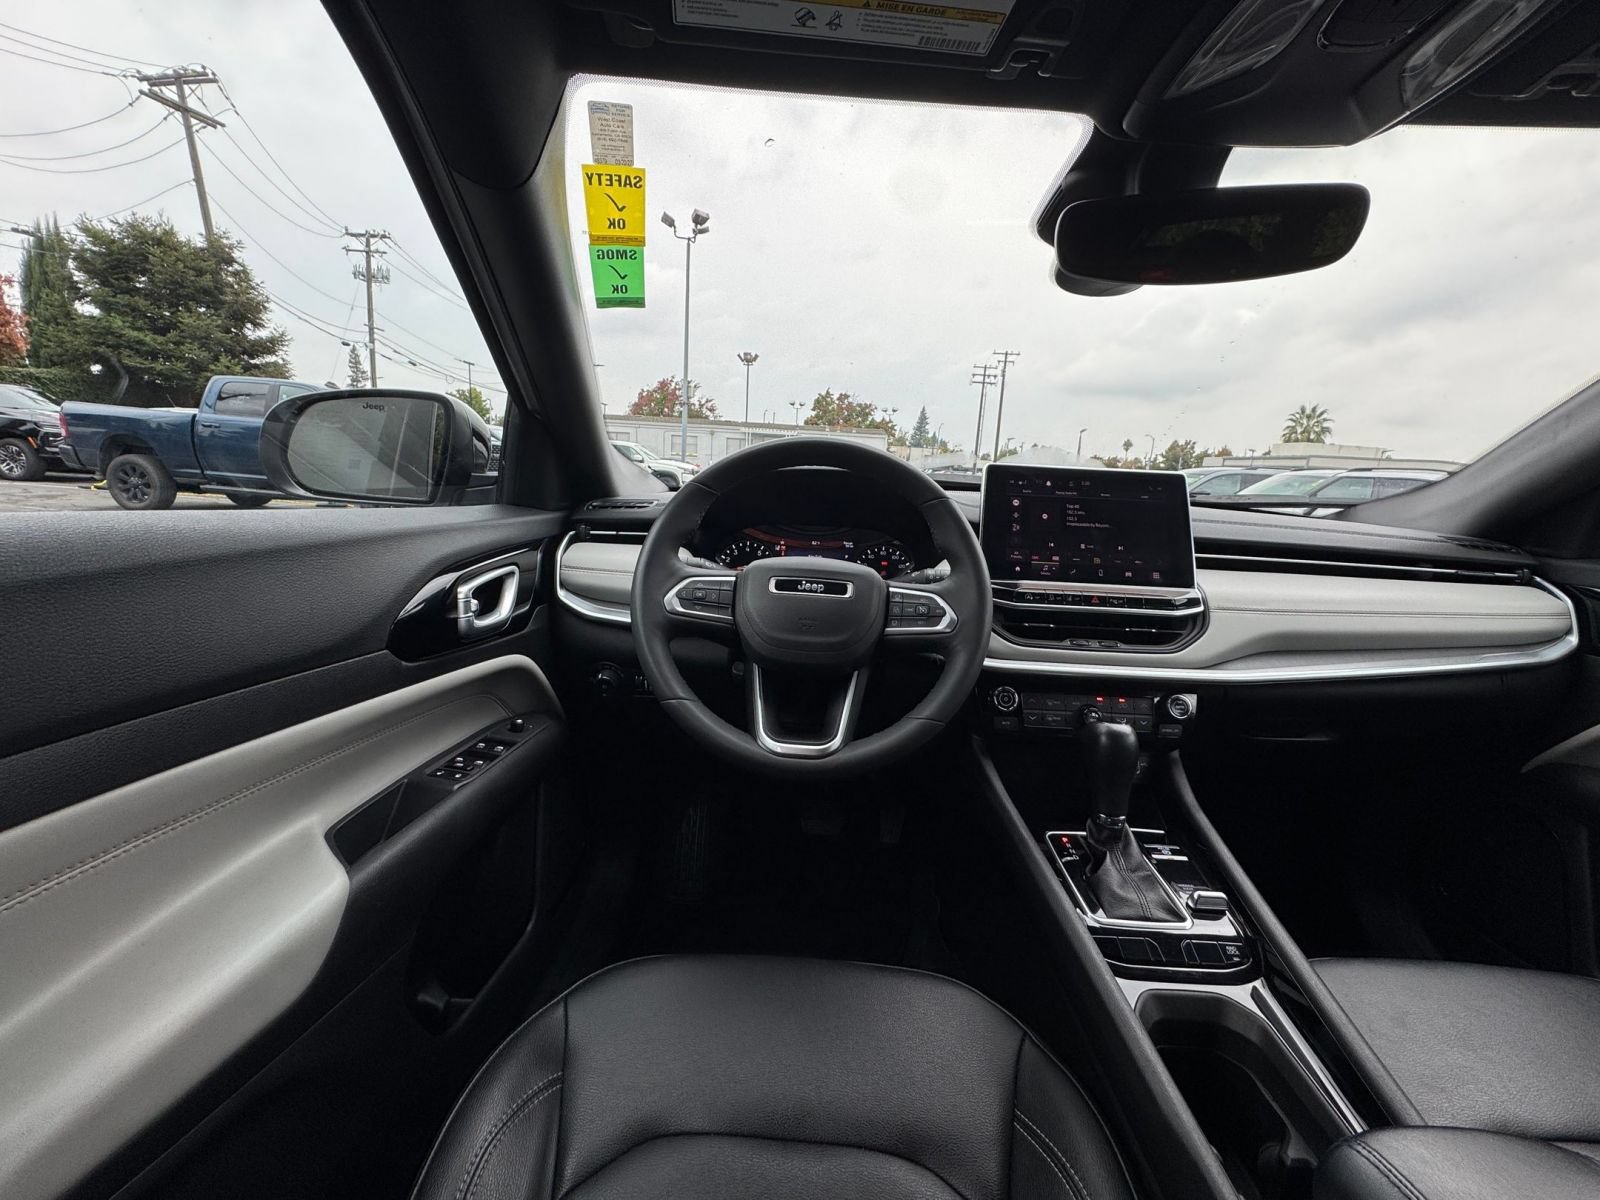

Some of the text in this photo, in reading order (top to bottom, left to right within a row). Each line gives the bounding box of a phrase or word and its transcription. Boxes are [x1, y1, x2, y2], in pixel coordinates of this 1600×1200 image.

[876, 2, 898, 11] MISE
[916, 6, 947, 16] GARDE
[362, 402, 385, 412] Jeep
[797, 580, 825, 593] Jeep
